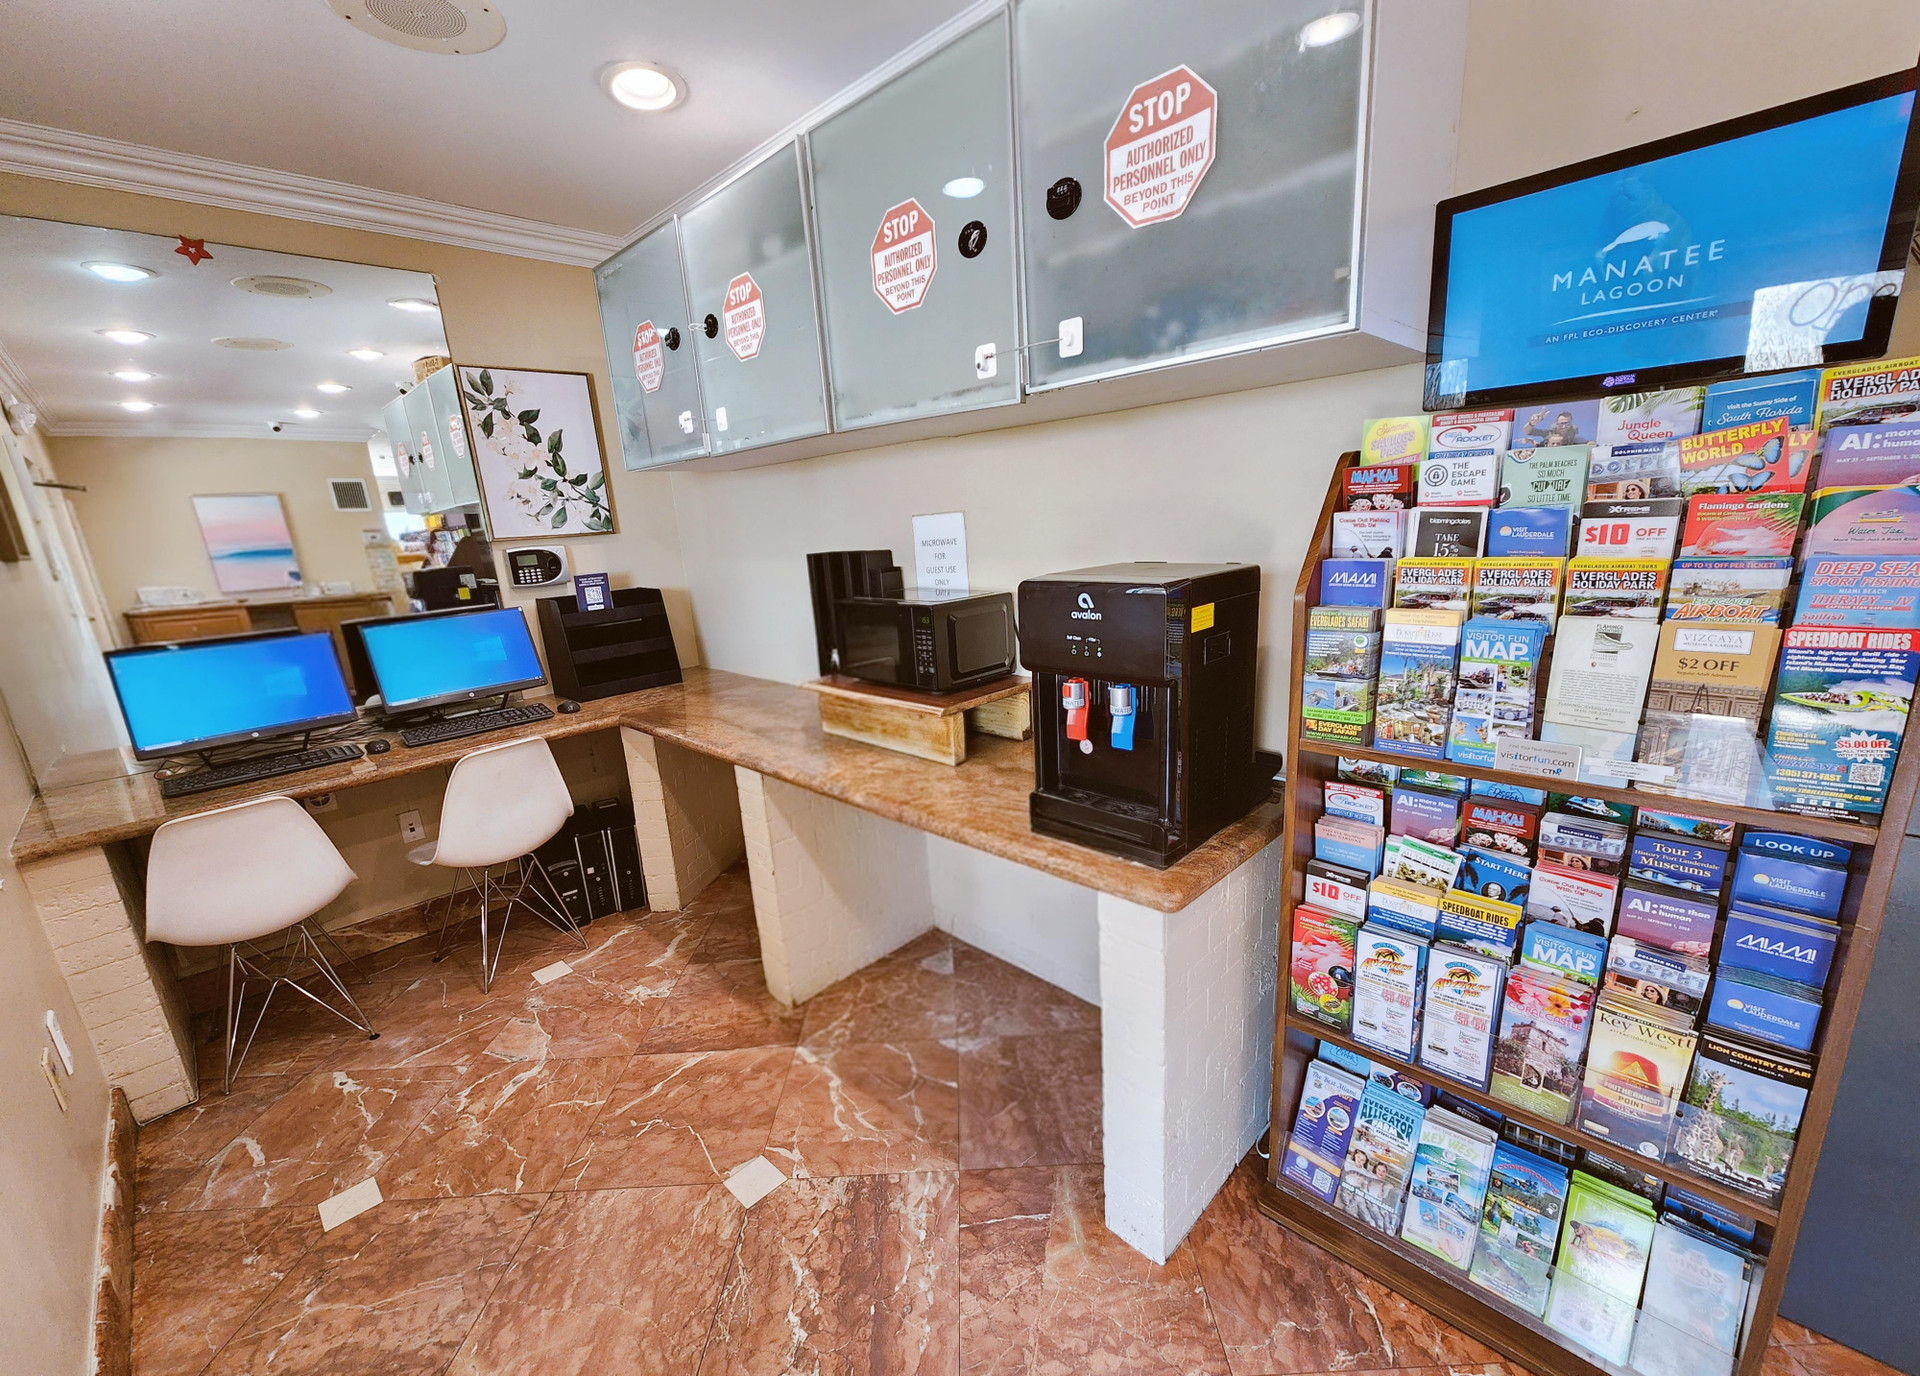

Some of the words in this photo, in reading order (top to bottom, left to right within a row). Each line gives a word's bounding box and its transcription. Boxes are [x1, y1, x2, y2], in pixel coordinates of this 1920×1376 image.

[1128, 81, 1192, 134] STOP
[1126, 125, 1194, 169] AUTHORIZED
[1112, 159, 1176, 194] PERSONNEL
[1179, 140, 1207, 169] ONLY
[1123, 182, 1168, 206] BEYOND
[1171, 170, 1194, 190] THIS
[1142, 192, 1176, 213] POINT
[883, 209, 919, 244] STOP
[884, 241, 923, 269] AUTHORIZED
[877, 261, 914, 287] PERSONNEL
[915, 254, 931, 273] ONLY
[1551, 239, 1726, 292] MANATEE
[729, 281, 752, 306] STOP
[885, 280, 910, 297] BEYOND
[911, 274, 926, 287] THIS
[1580, 274, 1685, 306] LAGOON
[896, 289, 915, 303] POINT
[637, 327, 656, 348] STOP
[1545, 335, 1560, 344] AN
[1563, 332, 1579, 341] FPL
[1582, 317, 1667, 338] ECO-DISCOVERY
[1617, 417, 1662, 431] Jungle
[1716, 411, 1752, 426] South
[1756, 405, 1803, 419] Florida
[1371, 431, 1416, 450] SAVINGS
[1456, 434, 1495, 443] ROCKET
[1627, 429, 1674, 442] Queen
[1682, 418, 1784, 451] BUTTERFLY
[1379, 442, 1408, 459] PASS
[1682, 442, 1744, 465] WORLD
[1452, 462, 1470, 470] THE
[1539, 461, 1554, 469] PALM
[1553, 459, 1578, 468] BEACHES
[1350, 467, 1399, 485] MAI-KAI
[1451, 469, 1487, 478] ESCAPE
[1537, 470, 1546, 479] SO
[1547, 469, 1565, 478] MUCH
[1450, 478, 1476, 487] GAME
[1527, 495, 1539, 503] SO
[1539, 494, 1556, 503] LITTLE
[1557, 493, 1571, 501] TIME
[1698, 502, 1745, 510] Flamingo
[1745, 501, 1789, 509] Gardens
[1429, 517, 1472, 525] bloomingdales
[1434, 533, 1460, 542] TAKE
[1585, 523, 1631, 545] $10
[1636, 527, 1668, 537] OFF
[1847, 527, 1876, 535] Water
[1881, 526, 1905, 535] Taxi
[921, 538, 958, 547] MICROWAVE
[926, 566, 945, 574] GUEST
[945, 565, 957, 573] USE
[1400, 567, 1464, 578] EVERGLADES
[1479, 569, 1553, 579] EVERGLADES
[1573, 571, 1657, 582] EVERGLADES
[1815, 561, 1876, 576] DEEP
[1876, 561, 1920, 577] SEA
[934, 578, 950, 586] ONLY
[1328, 572, 1377, 584] MIAMI
[1400, 575, 1438, 585] HOLIDAY
[1438, 576, 1464, 585] PARK
[1479, 577, 1523, 586] HOLIDAY
[1523, 578, 1552, 587] PARK
[1572, 580, 1620, 589] HOLIDAY
[1622, 580, 1655, 590] PARK
[1810, 576, 1861, 587] SPORT
[1860, 576, 1920, 588] FISHING
[1692, 597, 1753, 605] EVERGLADES
[1070, 609, 1102, 621] avalon
[1671, 603, 1771, 620] AIRBOAT
[1801, 613, 1846, 622] Sailfish
[1310, 615, 1346, 628] EVERGLADES
[1347, 615, 1369, 628] SAFARI
[1466, 632, 1505, 642] VISITOR
[1508, 634, 1530, 644] FUN
[1683, 632, 1744, 645] VIZCAYA
[1787, 630, 1867, 649] SPEEDBOAT
[1866, 632, 1912, 651] RIDES
[1465, 639, 1529, 661] MAP
[1678, 656, 1700, 670] $2
[1703, 659, 1740, 672] OFF
[1318, 721, 1362, 732] EVERGLADES
[1332, 727, 1357, 736] SAFARI
[1837, 739, 1869, 749] $5.00
[1870, 740, 1889, 748] OFF
[1500, 750, 1575, 769] visitorfun.com
[1418, 803, 1442, 813] human
[1471, 806, 1525, 827] MAI-KAI
[1653, 842, 1689, 857] Tour
[1692, 851, 1703, 860] 3
[1755, 838, 1804, 855] LOOK
[1809, 847, 1835, 859] UP
[1475, 856, 1502, 871] START
[1503, 866, 1529, 880] HERE
[1634, 849, 1661, 860] History
[1662, 854, 1677, 863] Fort
[1679, 857, 1720, 871] Lauderdale
[1639, 856, 1712, 878] Museums
[1538, 876, 1560, 886] Come
[1561, 881, 1575, 889] Out
[1576, 885, 1604, 898] Fishing
[1768, 881, 1826, 898] LAUDERDALE
[1770, 877, 1791, 885] VISIT
[1312, 881, 1340, 901] $10
[1342, 891, 1362, 901] OFF
[1442, 900, 1485, 920] SPEEDBOAT
[1485, 911, 1509, 927] RIDES
[1627, 898, 1658, 915] AI:
[1659, 904, 1685, 914] more
[1687, 908, 1711, 920] than
[1658, 909, 1692, 923] human
[1535, 936, 1573, 955] VISITOR
[1575, 949, 1597, 962] FUN
[1736, 933, 1816, 962] MIAMI
[1532, 943, 1596, 978] MAP
[1431, 977, 1492, 992] ADVENTURE
[1508, 1000, 1543, 1019] CORAL
[1544, 1013, 1583, 1031] CASTLE
[1743, 1003, 1766, 1012] VISIT
[1600, 1012, 1632, 1031] Key
[1743, 1007, 1800, 1028] LAUDERDALE
[1708, 1042, 1731, 1054] LION
[1731, 1051, 1776, 1070] COUNTRY
[1777, 1064, 1811, 1079] SAFARI
[1603, 1080, 1661, 1106] SOUTHERNMOST
[1363, 1097, 1415, 1124] EVERGLADES
[1617, 1095, 1645, 1110] POINT
[1359, 1107, 1414, 1140] ALLIGATOR
[1371, 1119, 1398, 1137] FARM
[1422, 1131, 1446, 1144] KEY
[1447, 1136, 1479, 1161] WEST
